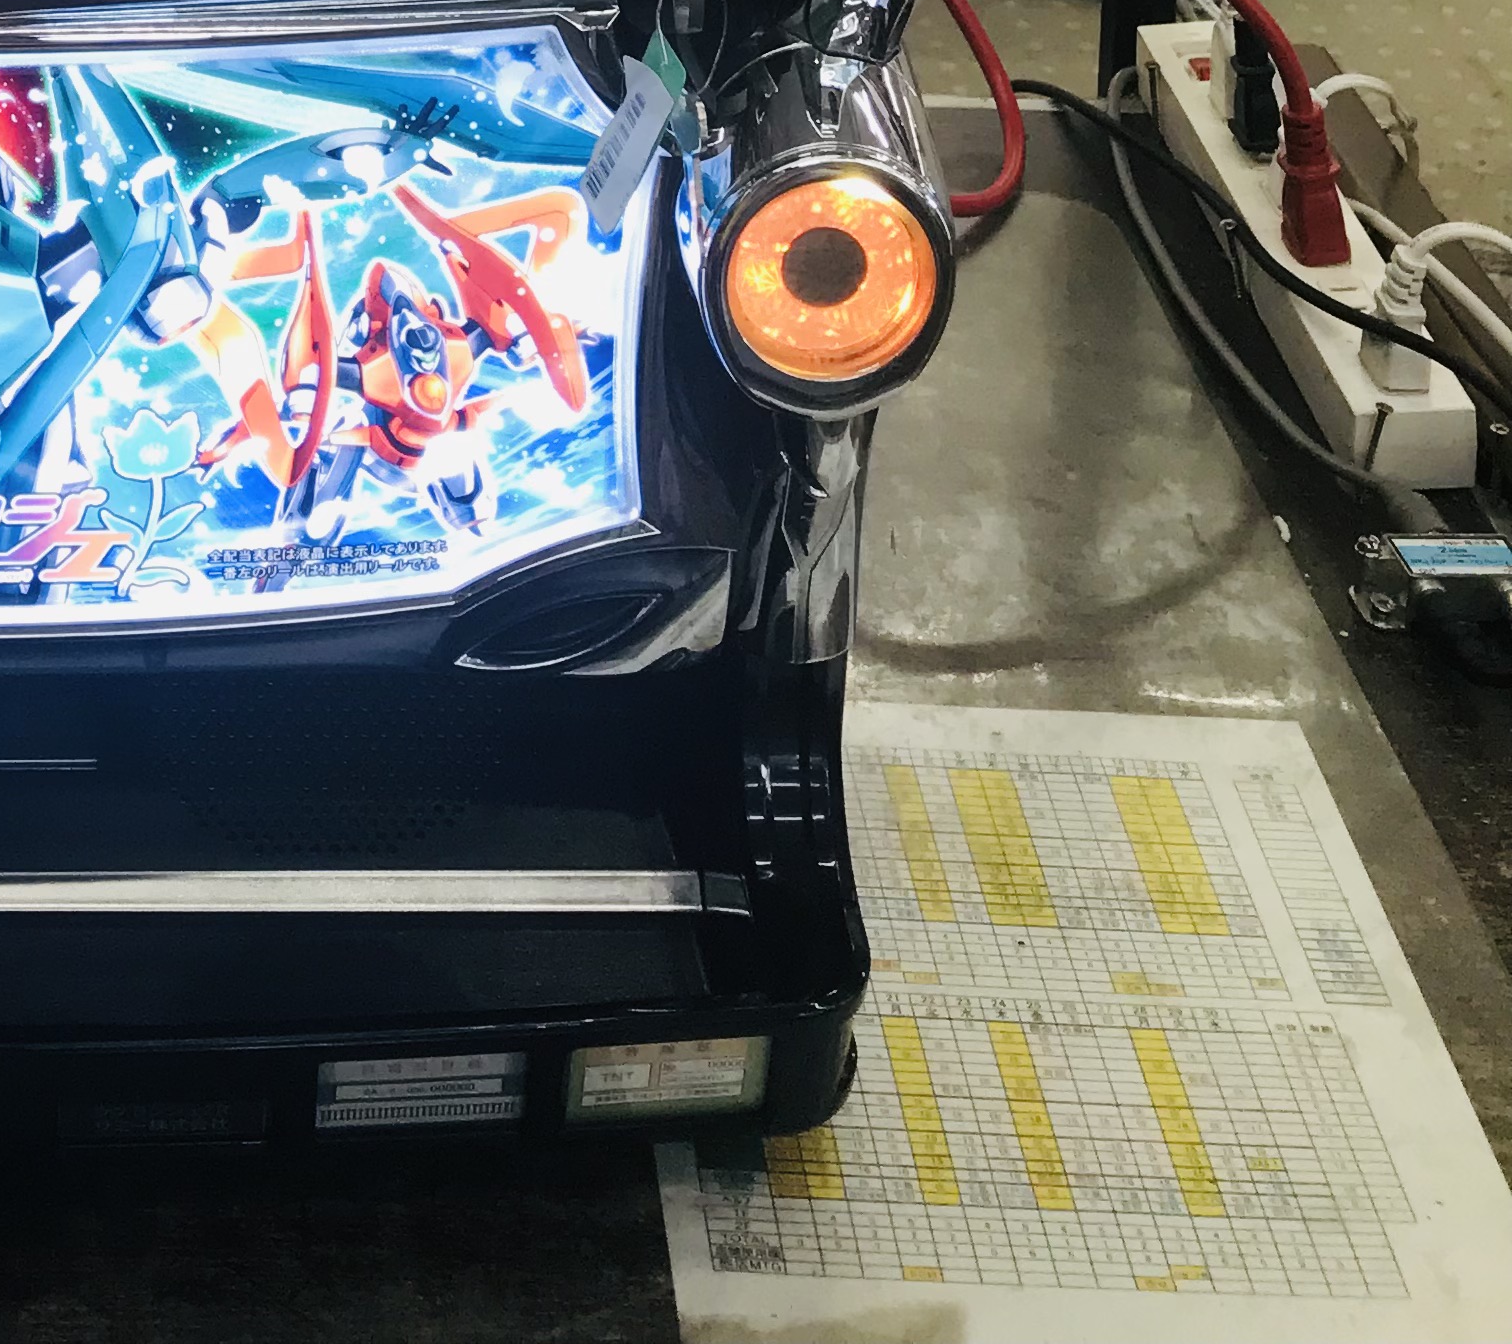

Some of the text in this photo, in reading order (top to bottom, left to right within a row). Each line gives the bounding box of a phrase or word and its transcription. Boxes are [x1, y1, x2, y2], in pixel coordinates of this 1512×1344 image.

[207, 539, 449, 563] 全配当表記は液晶に表示してあります。
